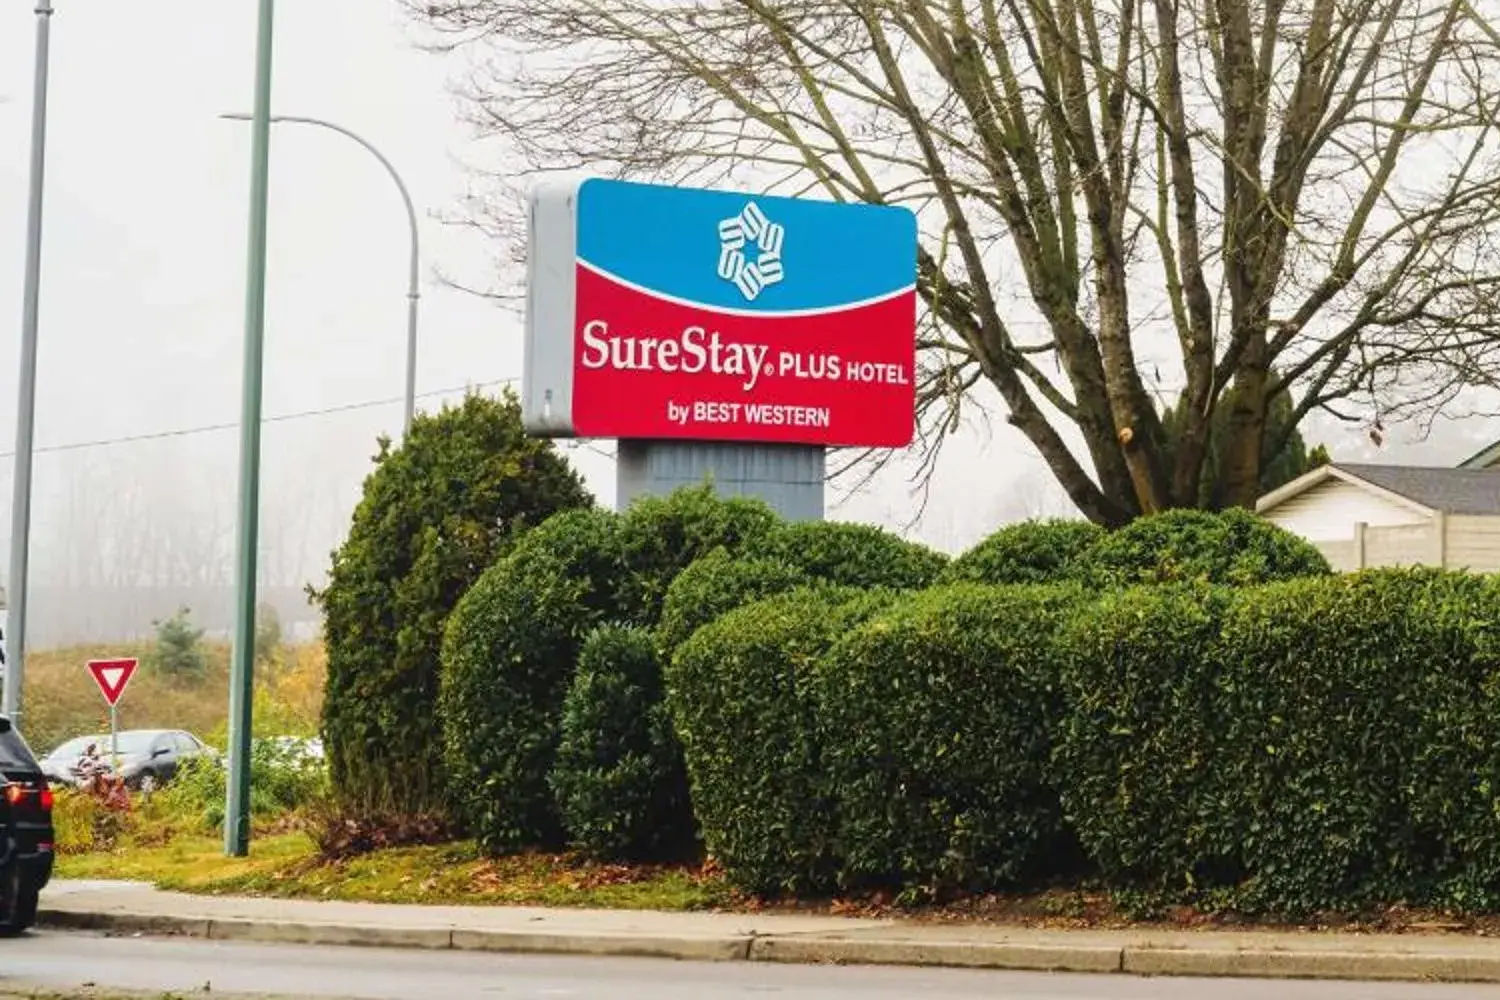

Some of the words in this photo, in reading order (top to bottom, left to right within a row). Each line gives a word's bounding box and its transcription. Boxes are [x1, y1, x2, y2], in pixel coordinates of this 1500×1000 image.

[779, 352, 841, 379] PLUS
[847, 364, 909, 385] HOTEL
[668, 402, 689, 425] by
[694, 401, 740, 423] BEST
[744, 404, 830, 426] WESTERN
